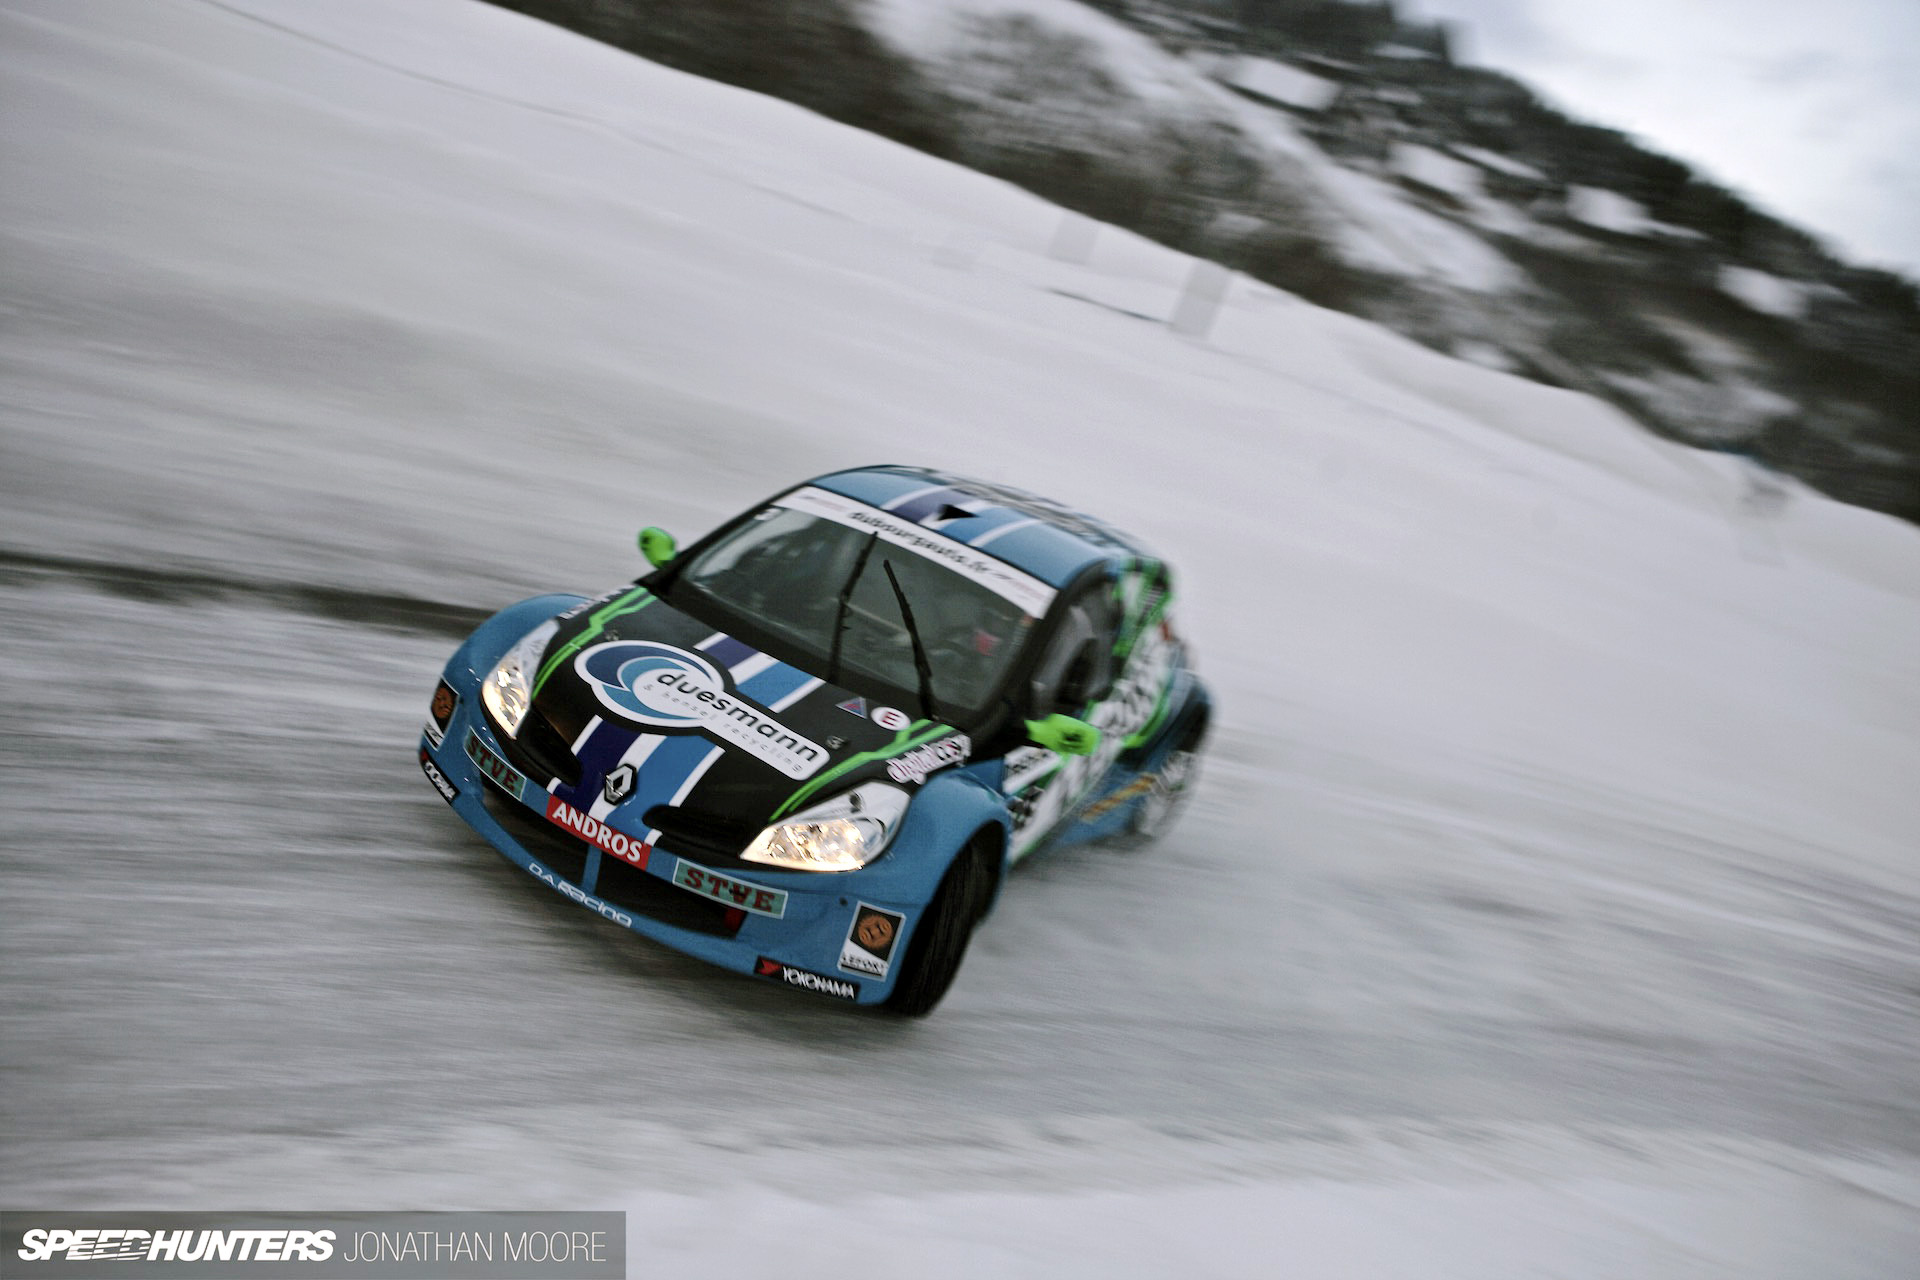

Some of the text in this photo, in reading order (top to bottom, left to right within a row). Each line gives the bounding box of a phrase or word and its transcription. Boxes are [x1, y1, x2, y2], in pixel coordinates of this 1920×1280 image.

[656, 672, 820, 763] duesmann
[722, 720, 803, 773] recycling
[552, 802, 642, 862] ANDROS
[782, 965, 855, 1000] YOKOHAMA
